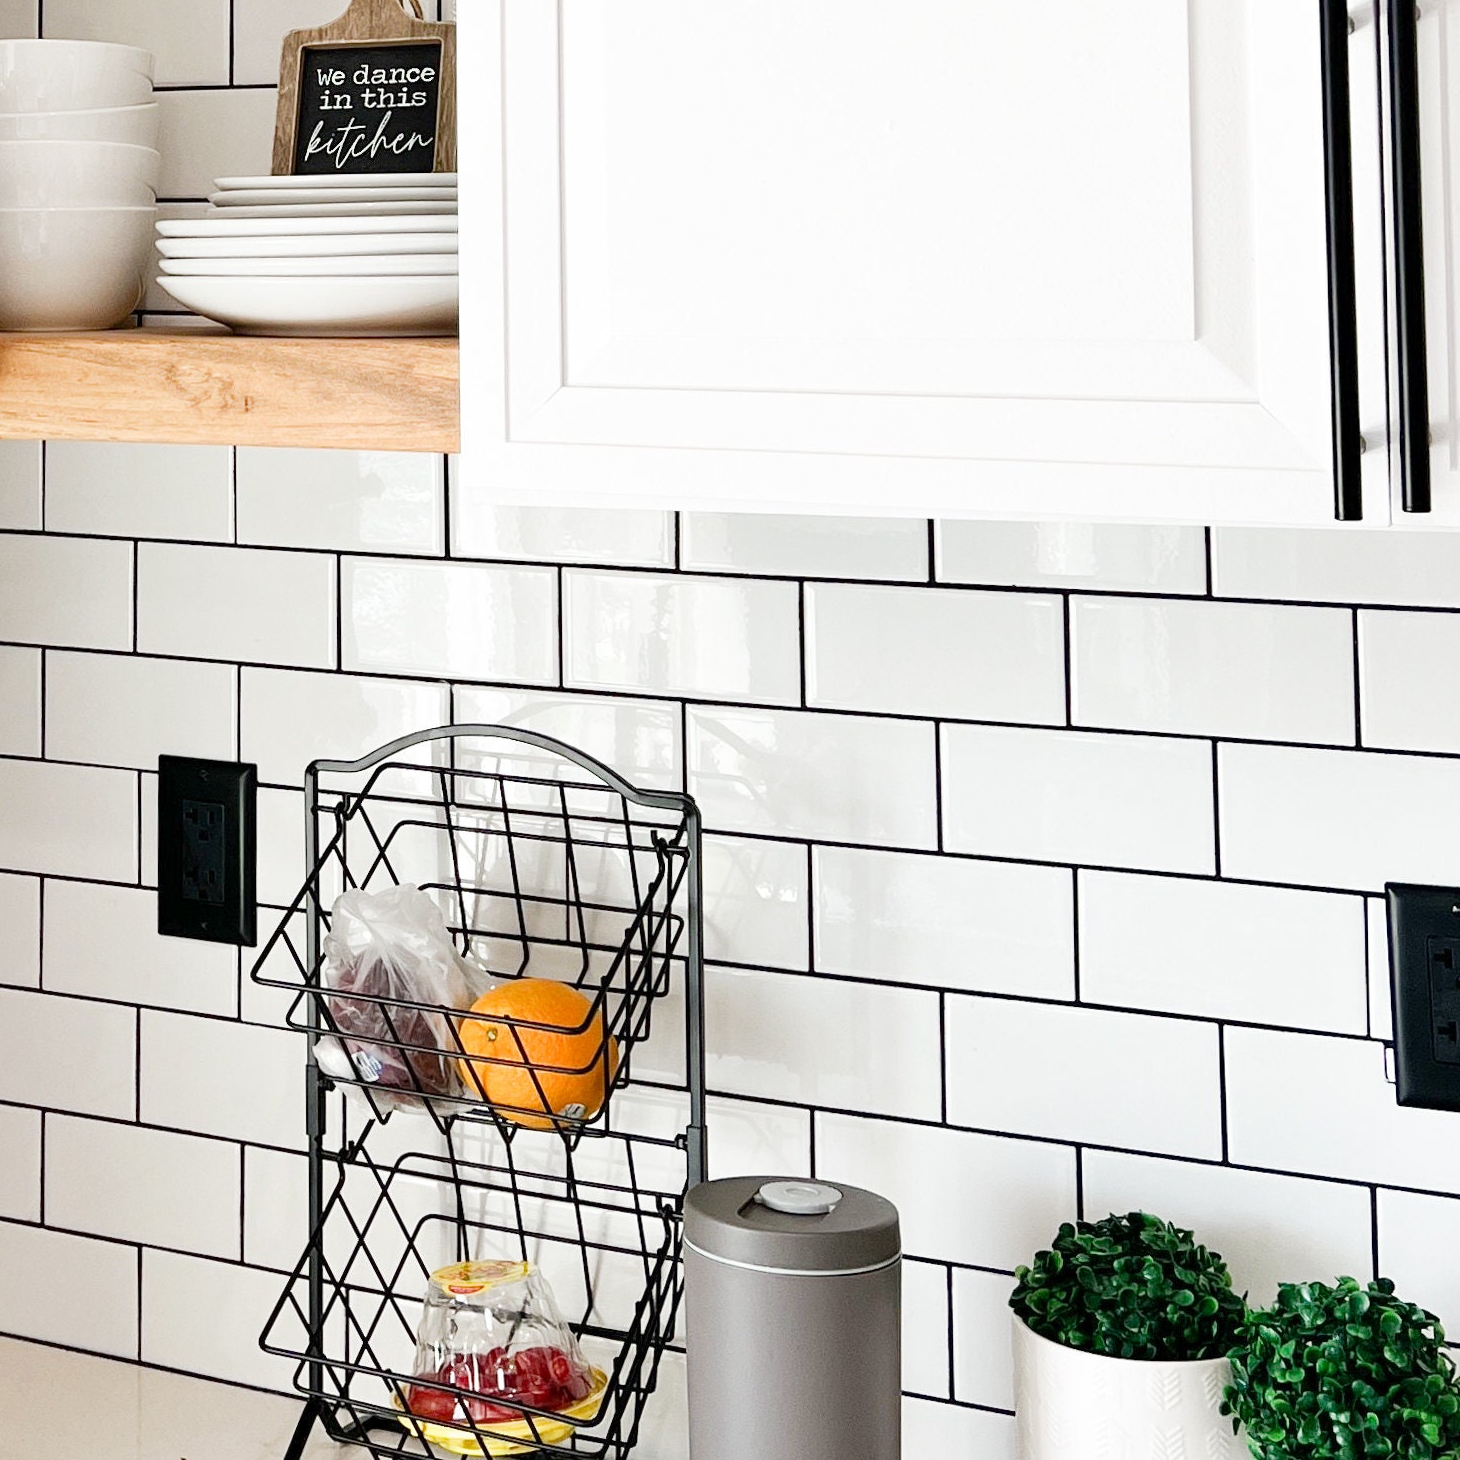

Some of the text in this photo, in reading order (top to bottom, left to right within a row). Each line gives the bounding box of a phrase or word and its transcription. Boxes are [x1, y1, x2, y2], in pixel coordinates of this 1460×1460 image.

[353, 65, 435, 85] dance
[319, 87, 427, 110] in this
[305, 111, 433, 169] kitchen
